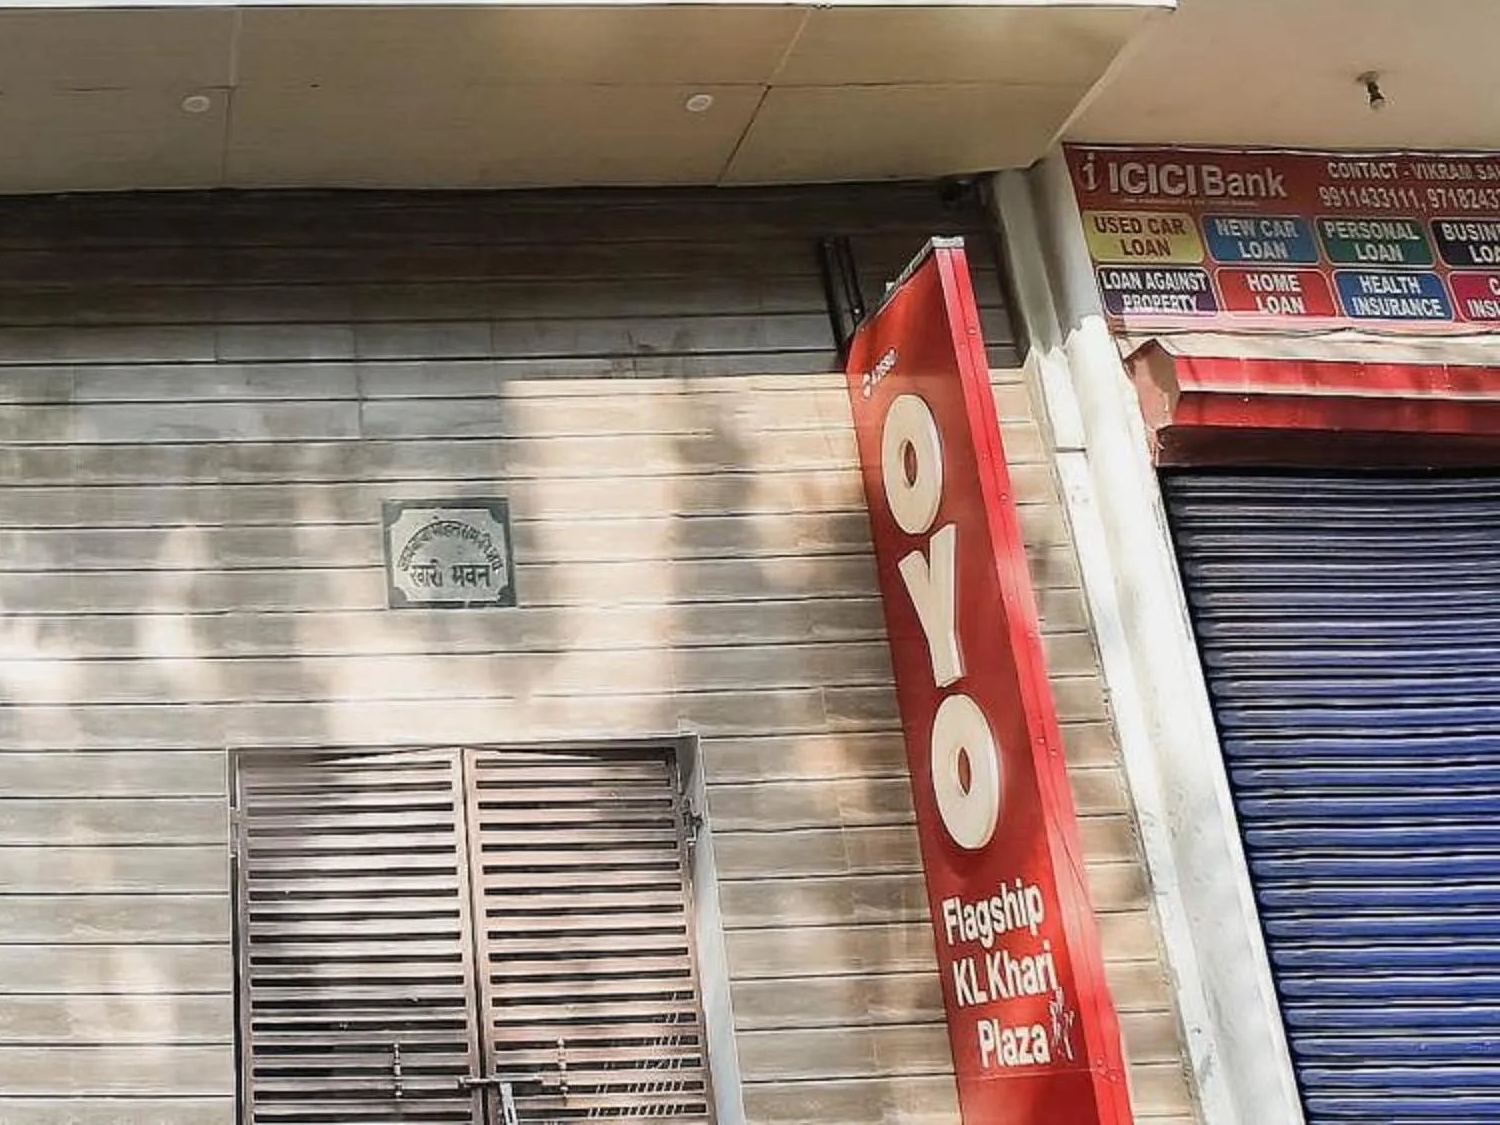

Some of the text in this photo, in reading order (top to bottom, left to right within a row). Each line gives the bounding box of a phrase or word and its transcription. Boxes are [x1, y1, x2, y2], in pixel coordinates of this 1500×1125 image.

[1327, 162, 1399, 180] CONTACT
[1093, 216, 1187, 236] USED CAR
[1214, 219, 1299, 238] NEW CAR
[1322, 221, 1420, 241] PERSONAL
[1119, 239, 1171, 257] LOAN
[1237, 241, 1289, 260] LOAN
[1355, 243, 1404, 262] LOAN
[1100, 271, 1208, 292] LOAN AGAINST
[1246, 273, 1301, 292] HOME
[1359, 275, 1422, 295] HEALTH
[1121, 294, 1199, 313] PROPERTY
[1255, 295, 1306, 315] LOAN
[1351, 297, 1445, 316] INSURANCE
[942, 878, 1045, 948] Flagship
[953, 939, 1059, 1007] KL Khari
[977, 1018, 1051, 1069] Plaza
